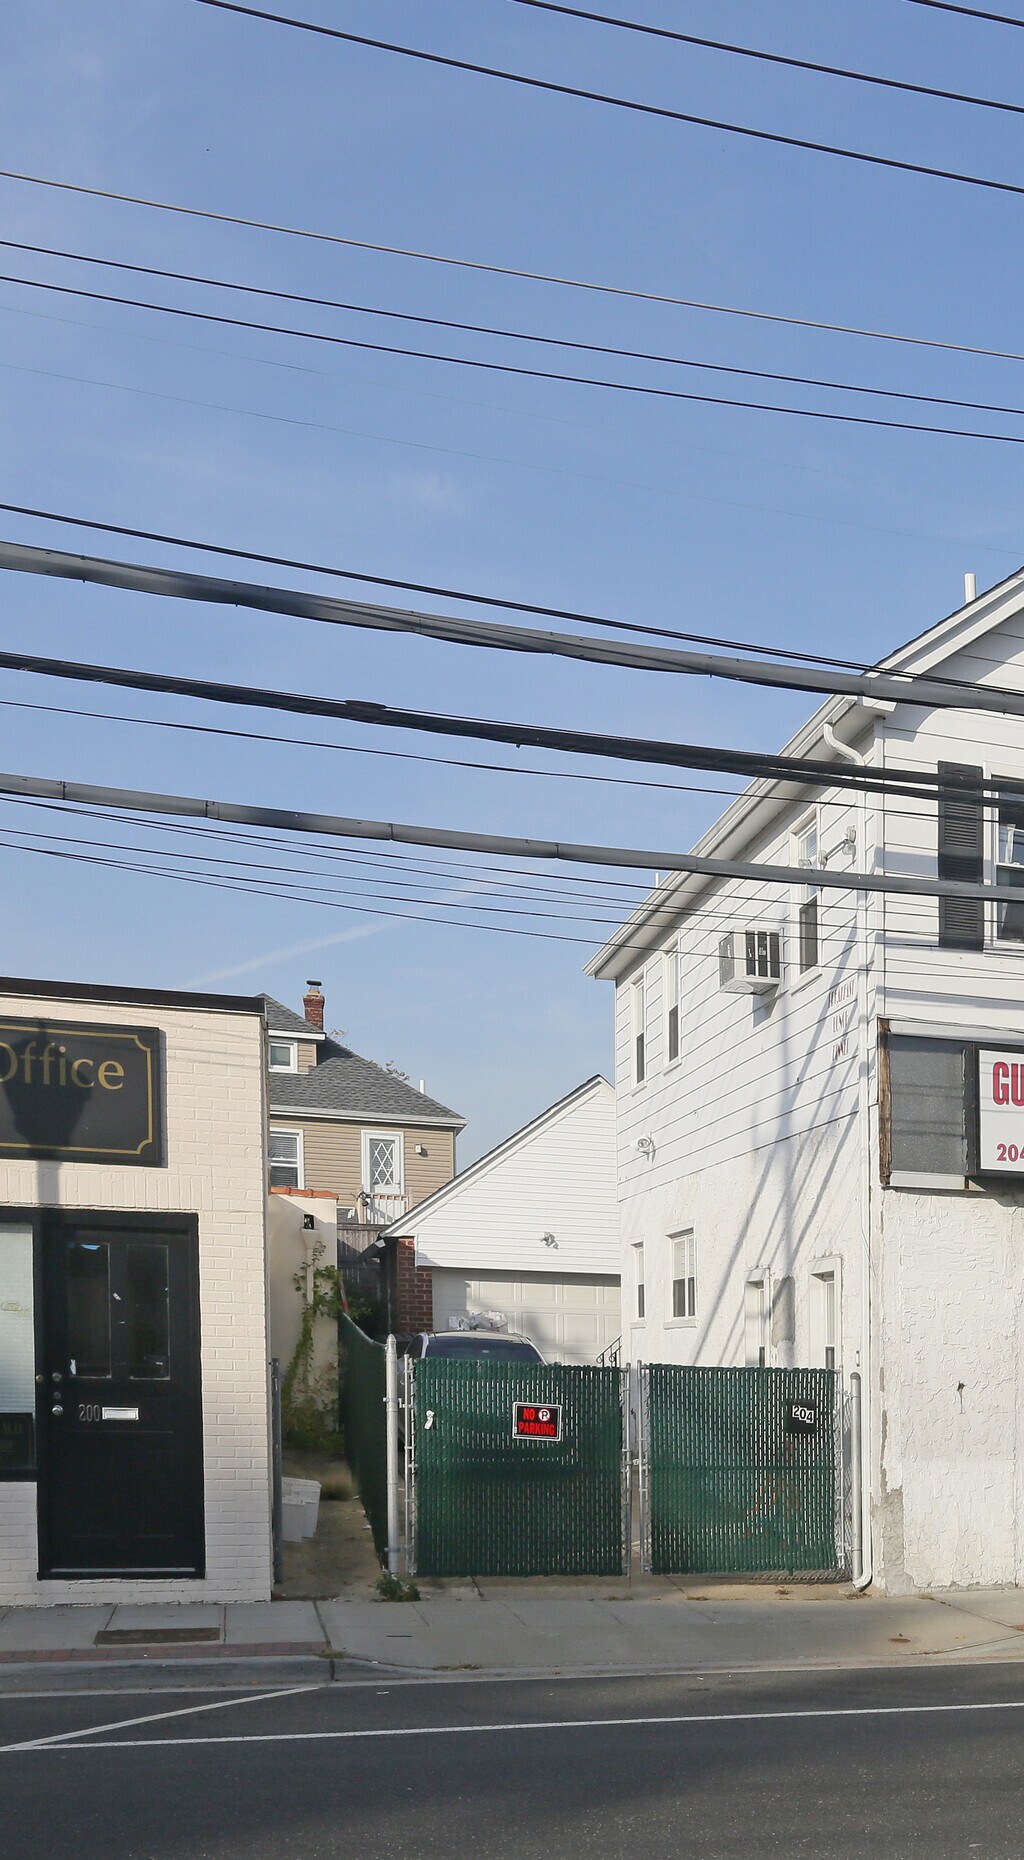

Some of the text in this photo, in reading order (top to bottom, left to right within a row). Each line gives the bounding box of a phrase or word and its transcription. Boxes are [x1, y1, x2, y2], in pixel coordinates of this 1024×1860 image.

[78, 1404, 100, 1421] 200
[523, 1407, 535, 1420] NO
[793, 1405, 814, 1423] 204
[518, 1421, 556, 1436] PARKING
